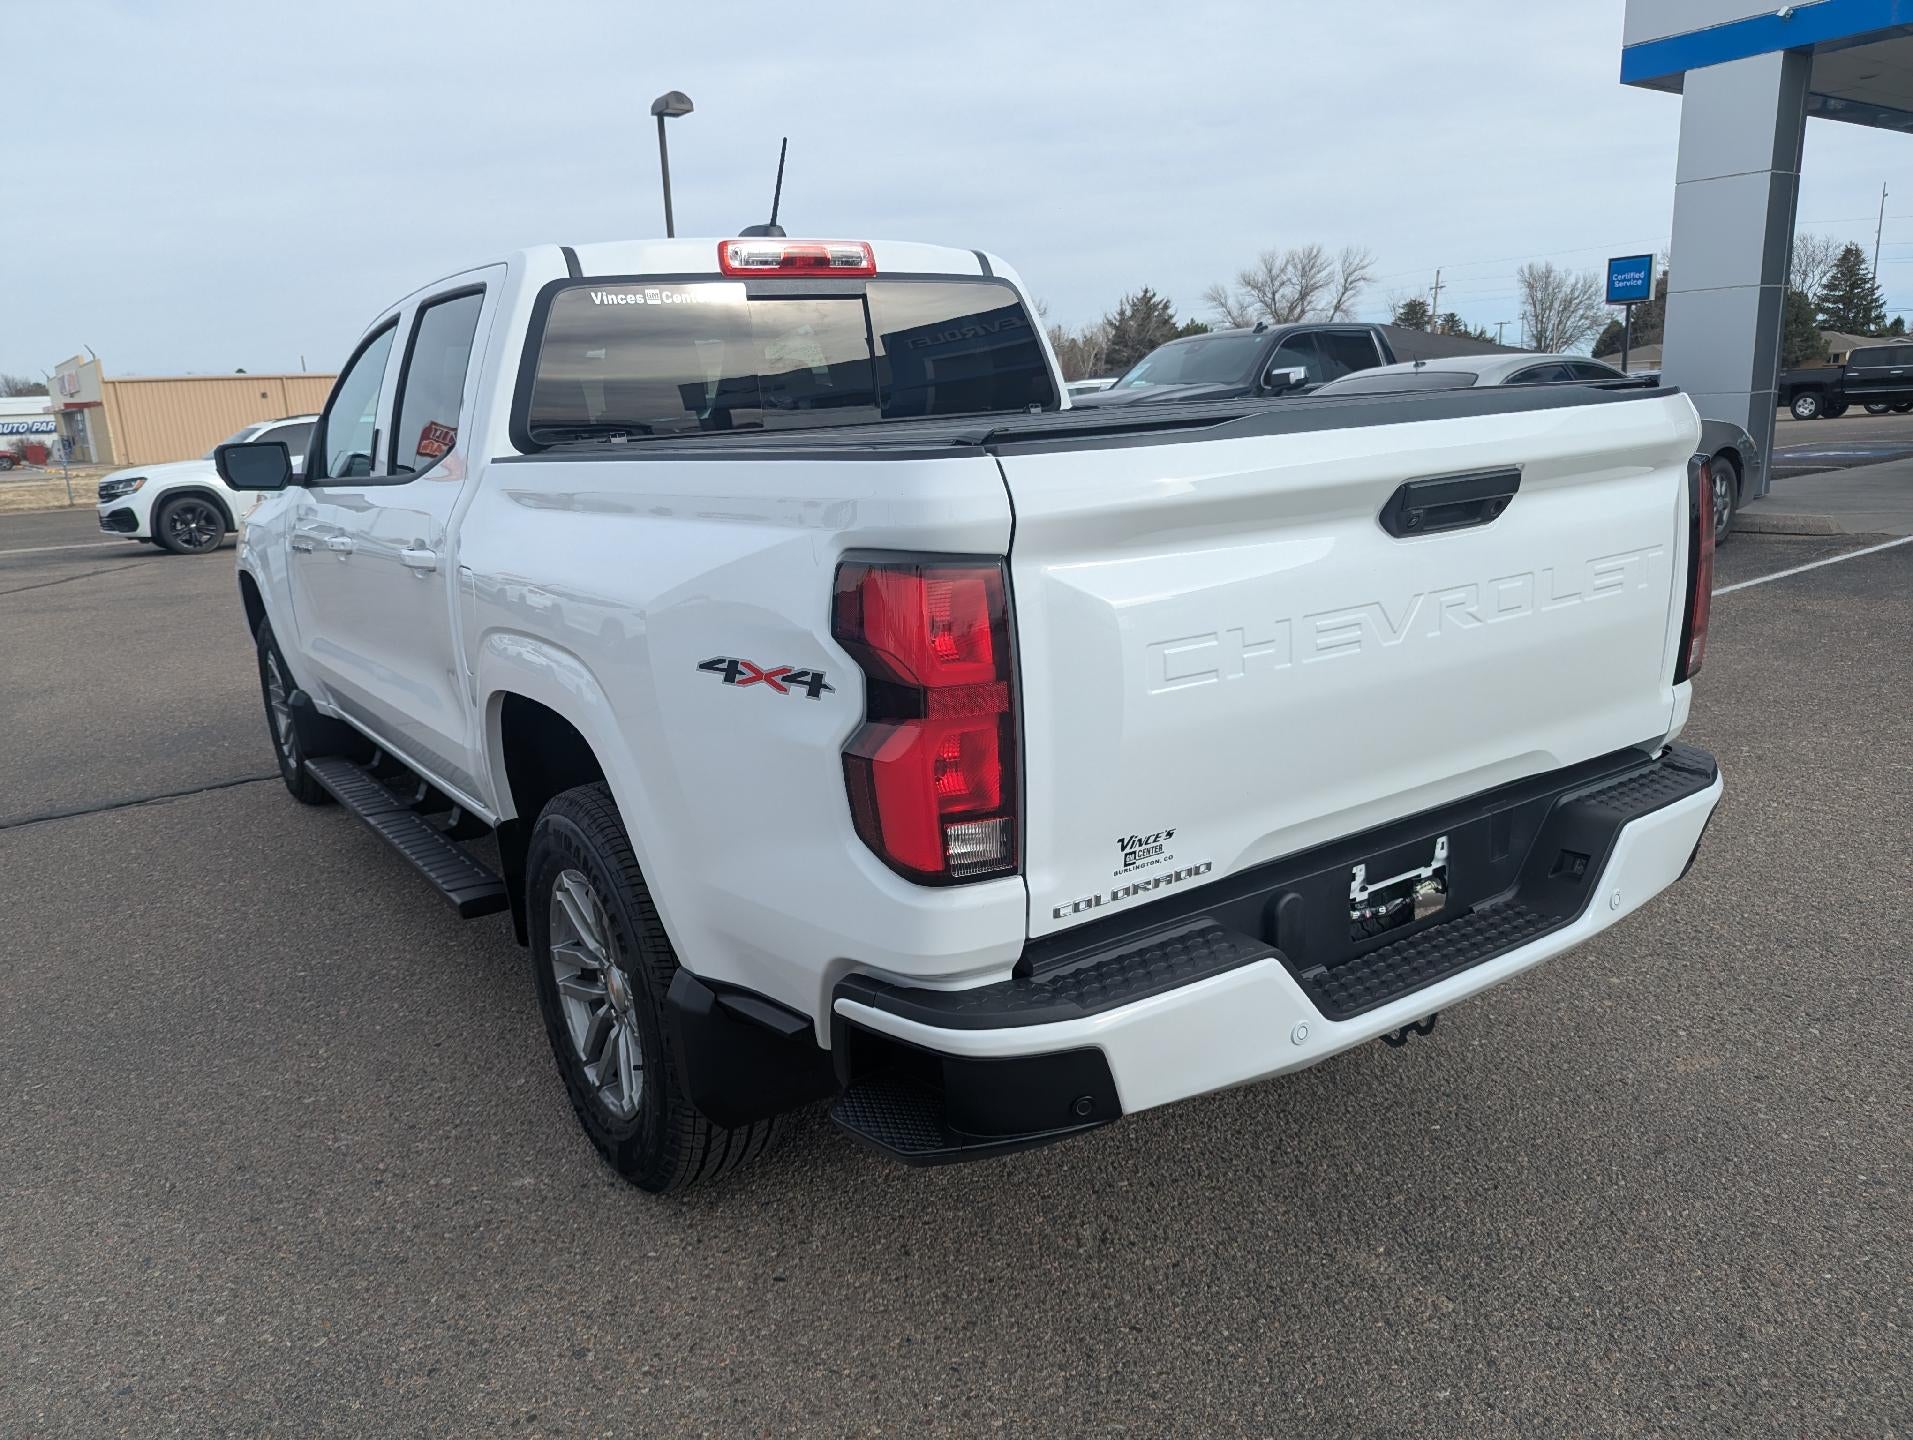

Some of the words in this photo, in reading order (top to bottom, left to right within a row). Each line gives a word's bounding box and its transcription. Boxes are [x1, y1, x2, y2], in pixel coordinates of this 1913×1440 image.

[1612, 271, 1645, 281] Certified
[1614, 279, 1642, 288] Service
[590, 290, 645, 305] Vinces
[1147, 544, 1664, 695] CHEVROLET
[1137, 843, 1163, 858] CENTER
[1163, 854, 1174, 862] CO
[1052, 861, 1213, 919] COLORADO
